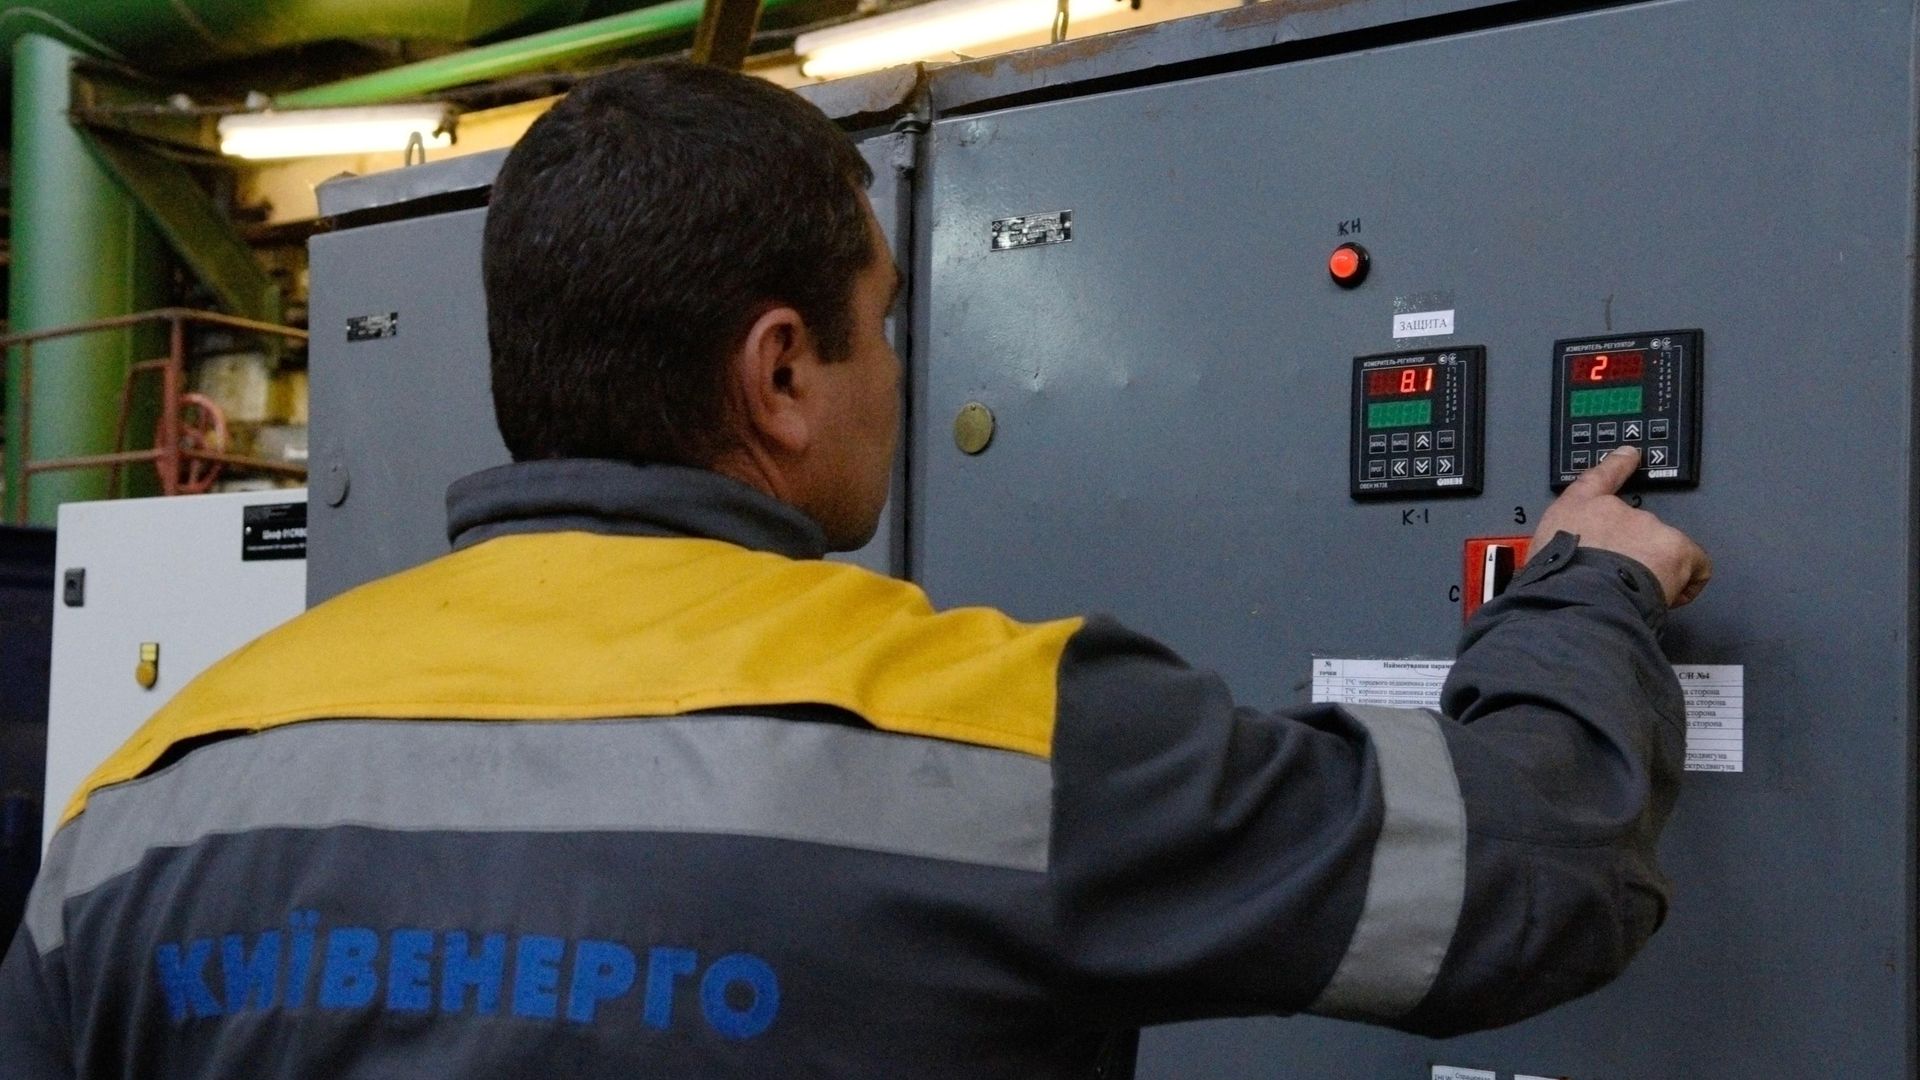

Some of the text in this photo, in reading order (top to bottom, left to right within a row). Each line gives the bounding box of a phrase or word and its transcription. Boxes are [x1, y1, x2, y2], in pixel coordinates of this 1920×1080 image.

[1399, 318, 1448, 331] ЗАЩИТА
[1566, 341, 1636, 352] ИЗМЕРИТЕЛЬ-РЕГУЛЯТОР
[1363, 356, 1425, 367] ИЗМЕРИТЕЛЬ-РЕГУЛЯТОР
[1590, 355, 1608, 380] 2
[1400, 367, 1433, 393] 8.1
[1684, 764, 1736, 772] ектродвигуна
[155, 909, 780, 1041] КИЇВЕНЕРГО
